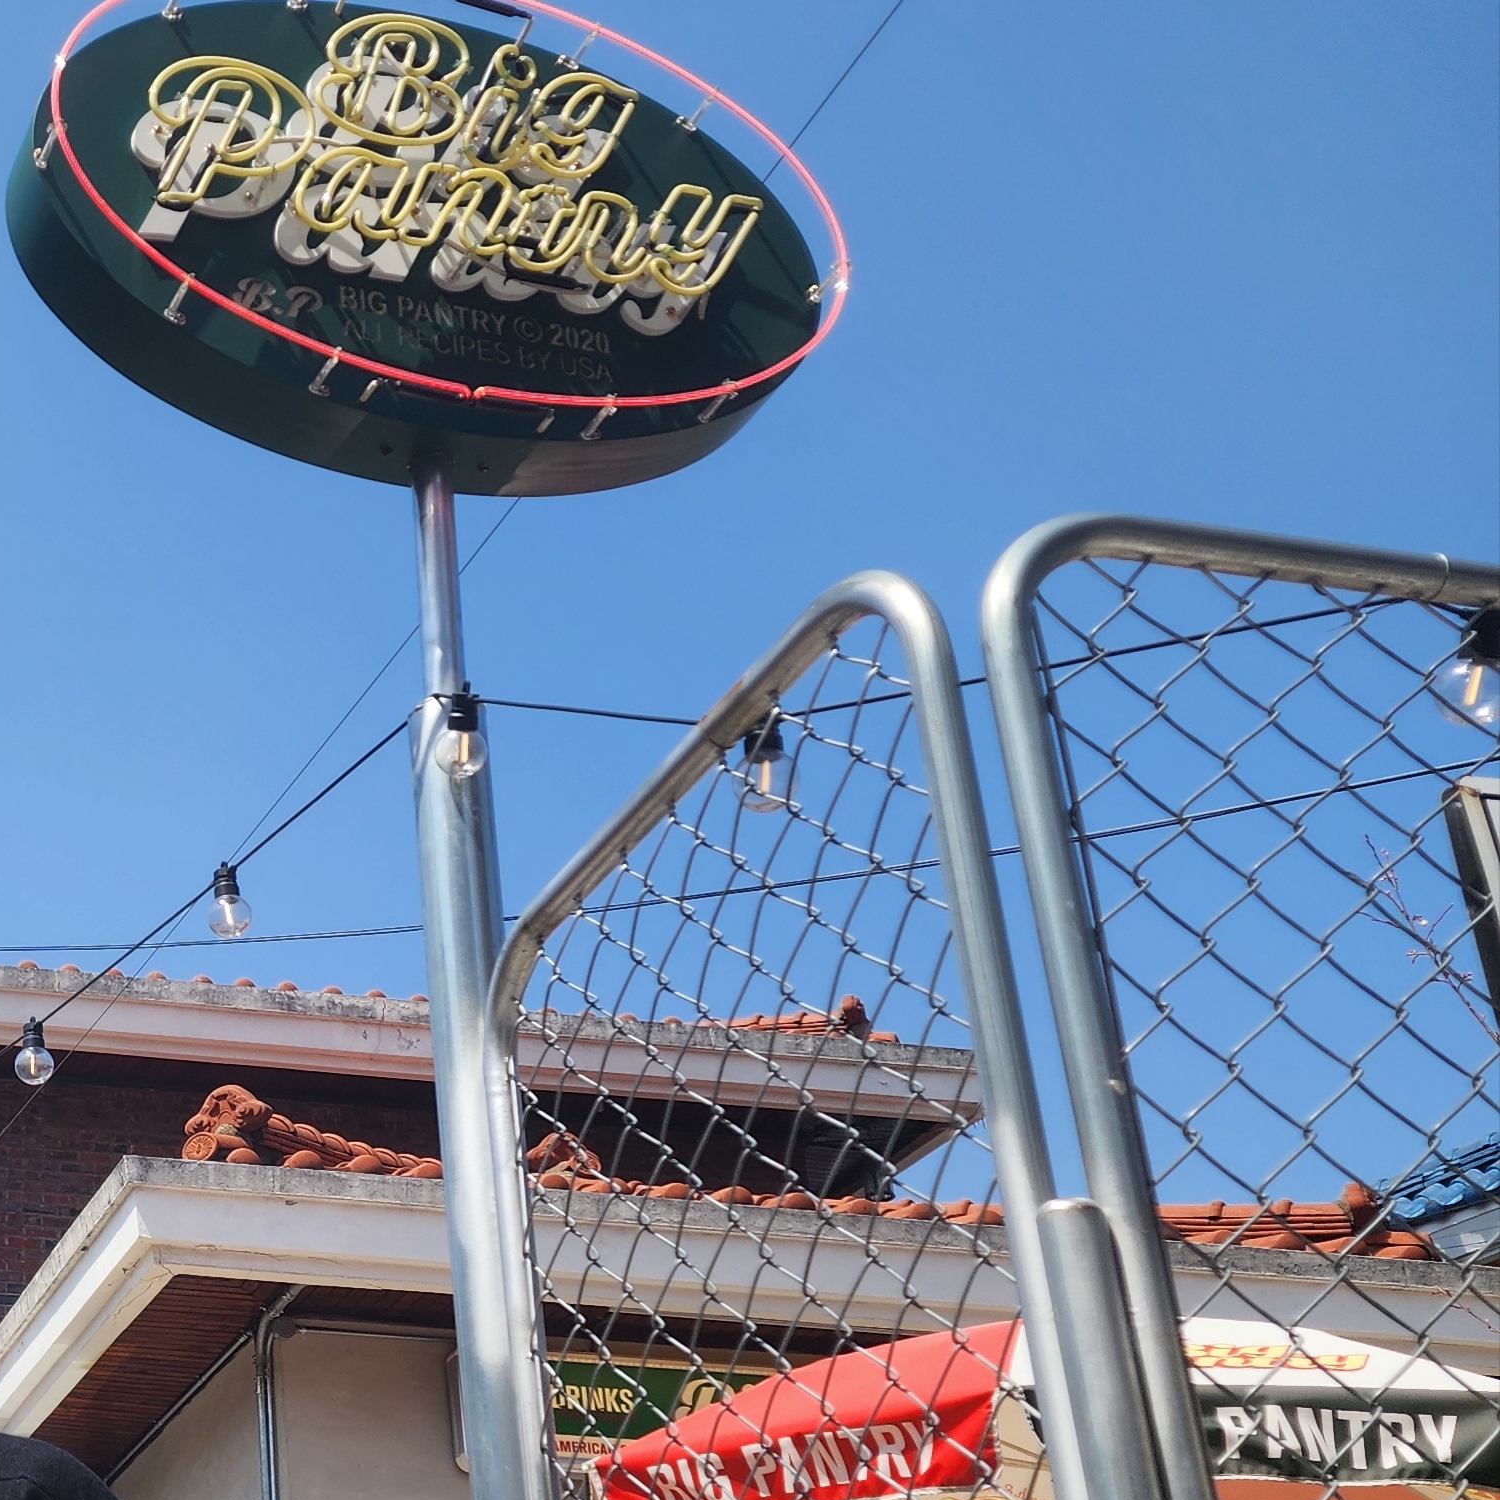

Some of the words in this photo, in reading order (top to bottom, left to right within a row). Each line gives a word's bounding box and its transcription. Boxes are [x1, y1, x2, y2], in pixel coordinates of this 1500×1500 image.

[300, 14, 639, 182] Big
[140, 55, 763, 310] Pantry
[339, 285, 387, 315] BIG
[398, 296, 505, 334] PANTRY
[550, 322, 611, 354] 2020
[399, 328, 511, 365] RECIPES
[518, 346, 550, 372] BY
[560, 353, 614, 384] USA
[1184, 1343, 1291, 1358] ig
[741, 1418, 938, 1497] PANTRY
[1215, 1404, 1457, 1471] PANTRY
